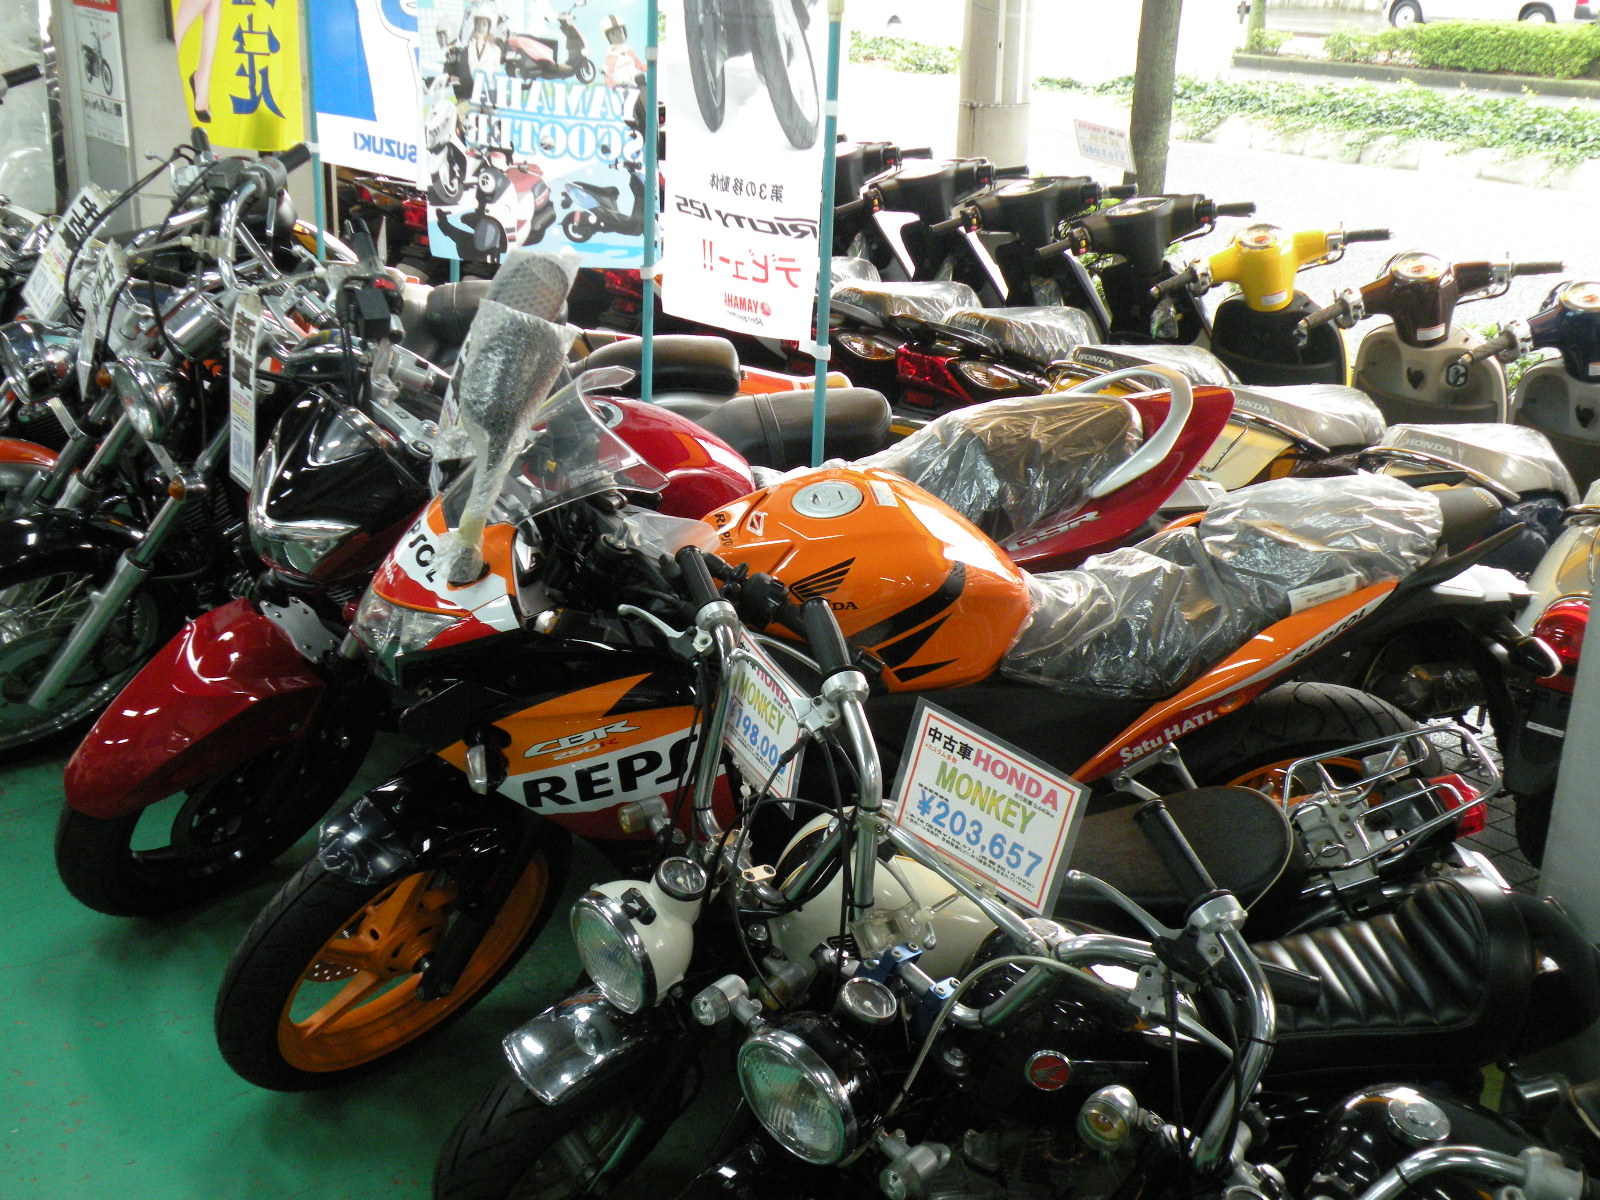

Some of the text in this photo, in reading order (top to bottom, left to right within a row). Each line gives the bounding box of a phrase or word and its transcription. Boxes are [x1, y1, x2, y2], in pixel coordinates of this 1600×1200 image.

[1078, 353, 1114, 368] HONDA
[1404, 437, 1454, 455] HONDA
[738, 671, 786, 736] MONKEY
[523, 719, 641, 758] CBR
[927, 726, 1058, 811] 中古車 HONDA
[1119, 735, 1163, 763] Satu
[523, 735, 700, 809] REPS
[935, 760, 1036, 835] MONKEY
[917, 789, 1043, 878] ¥203,657
